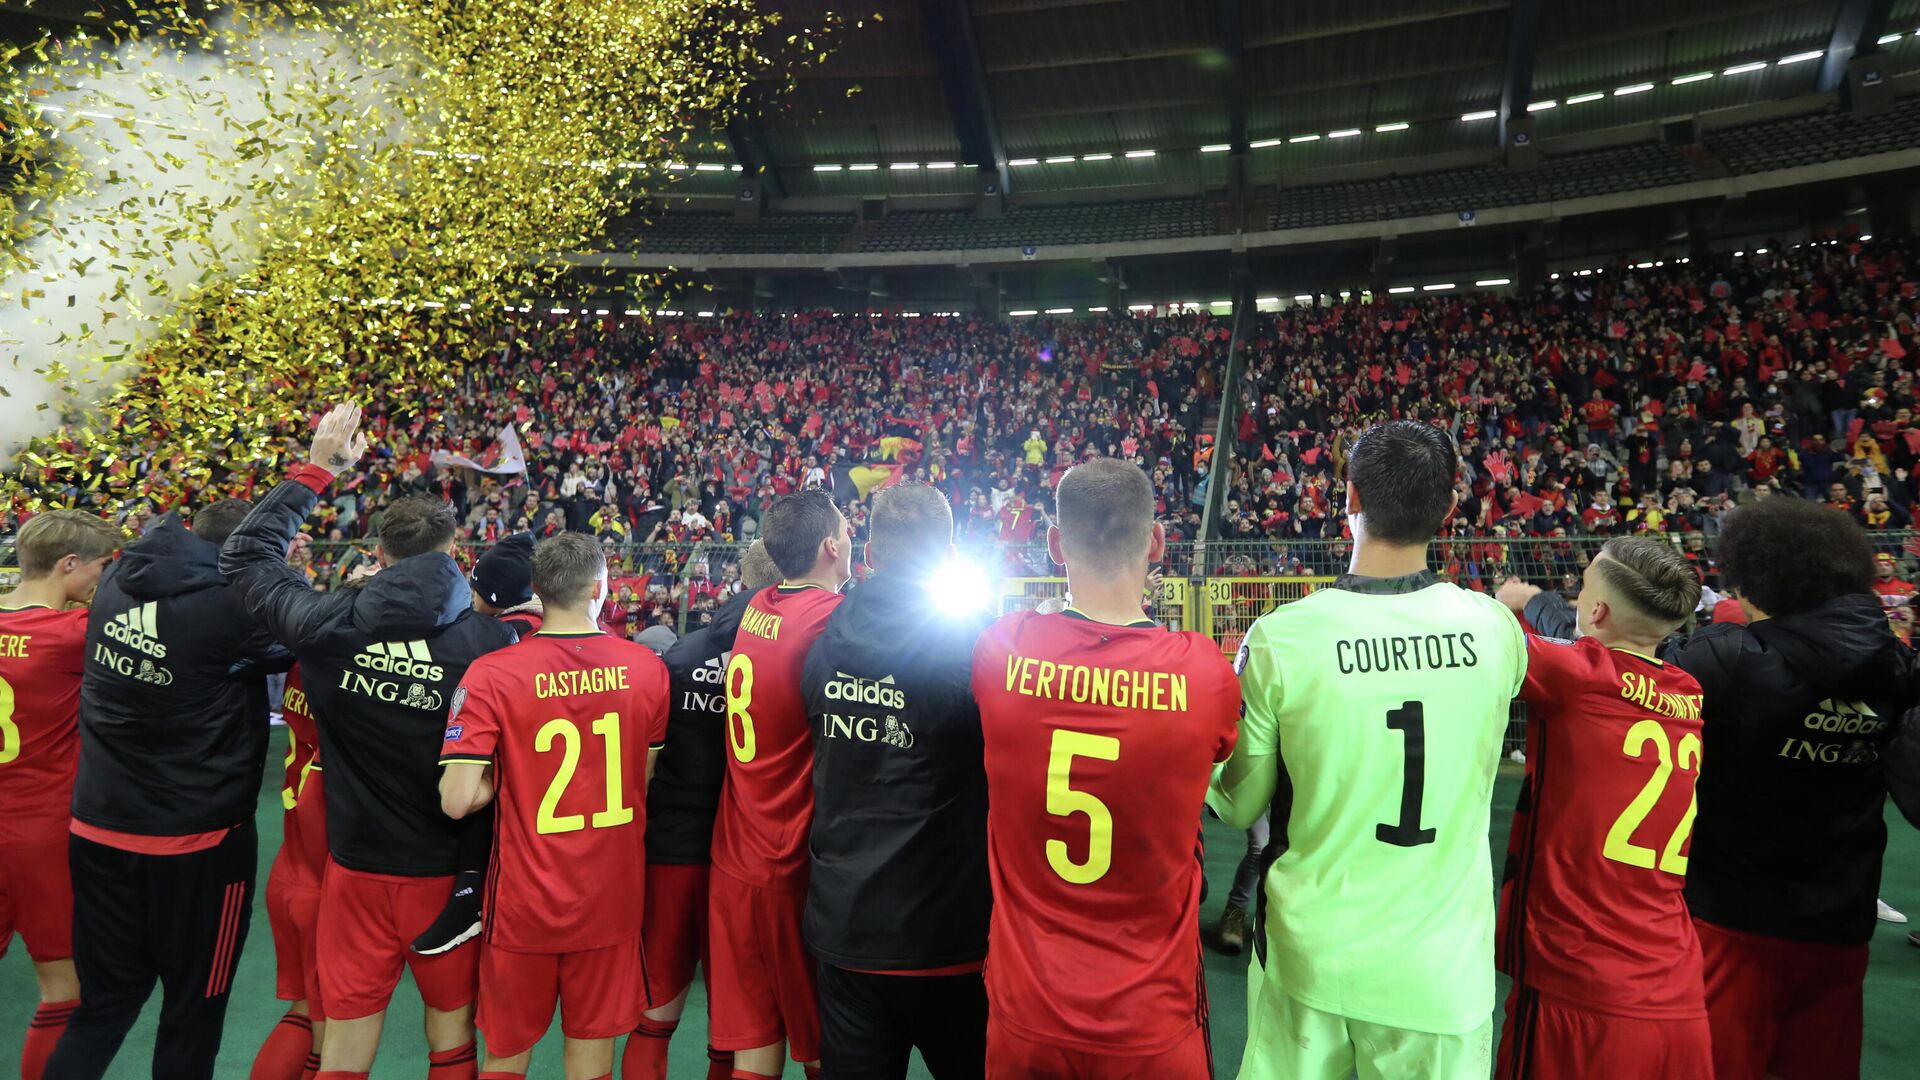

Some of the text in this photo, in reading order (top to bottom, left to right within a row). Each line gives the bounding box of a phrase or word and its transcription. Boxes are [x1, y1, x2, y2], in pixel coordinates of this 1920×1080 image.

[1165, 582, 1184, 601] 31
[1210, 582, 1231, 601] 30
[103, 621, 168, 659] adidas
[1336, 632, 1478, 675] COURTOIS
[94, 642, 135, 676] ING
[353, 653, 444, 682] adidas
[338, 669, 400, 702] ING
[535, 666, 630, 698] CASTAGNE
[824, 678, 906, 710] adidas
[1006, 654, 1188, 712] VERTONGHEN
[682, 691, 727, 713] ING
[725, 653, 756, 763] 8
[823, 713, 879, 743] ING
[1803, 712, 1889, 734] adidas
[1777, 737, 1842, 763] ING
[534, 711, 634, 834] 21
[1375, 700, 1437, 848] 1
[1045, 728, 1121, 885] 5
[1602, 719, 1701, 876] 22
